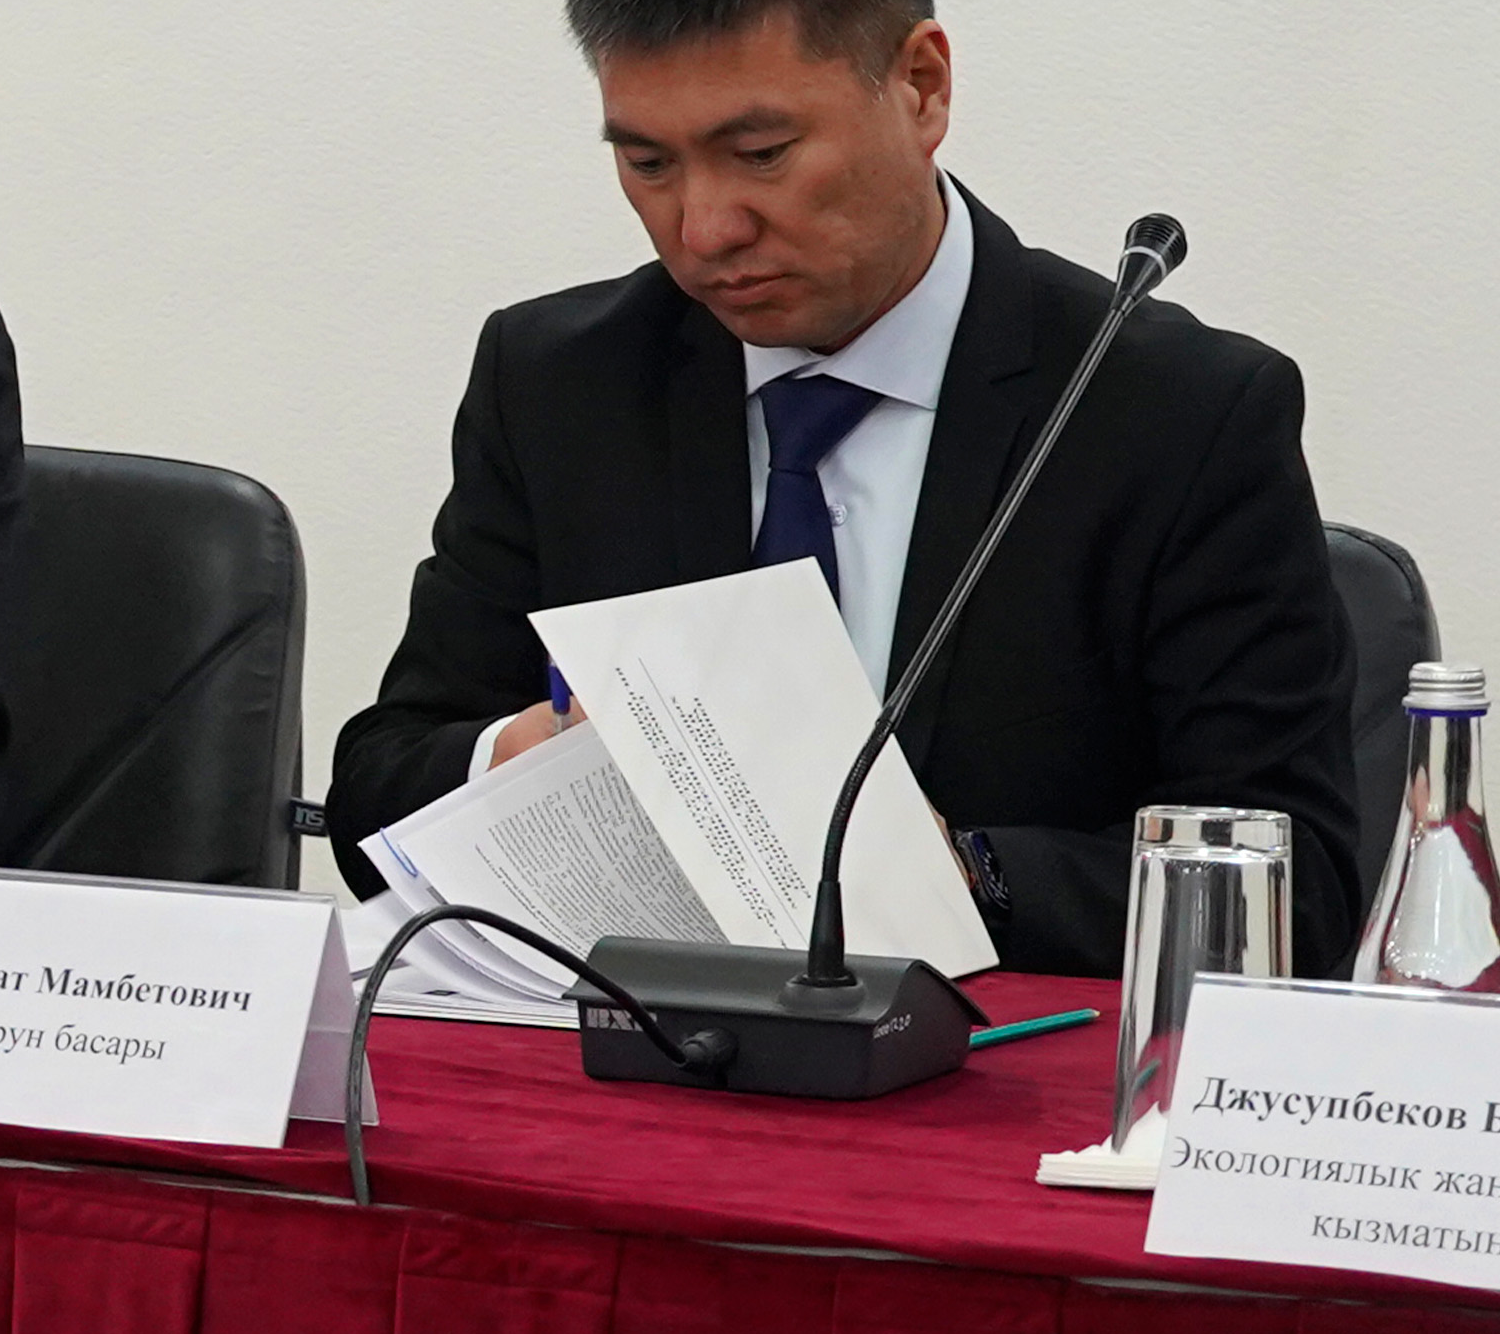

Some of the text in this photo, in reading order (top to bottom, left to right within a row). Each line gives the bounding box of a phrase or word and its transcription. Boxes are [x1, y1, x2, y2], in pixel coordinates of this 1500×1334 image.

[36, 966, 252, 1012] Мамбетович
[54, 1024, 166, 1065] басары
[1192, 1076, 1467, 1130] Джусупбеков
[1170, 1136, 1422, 1190] Экологиялык
